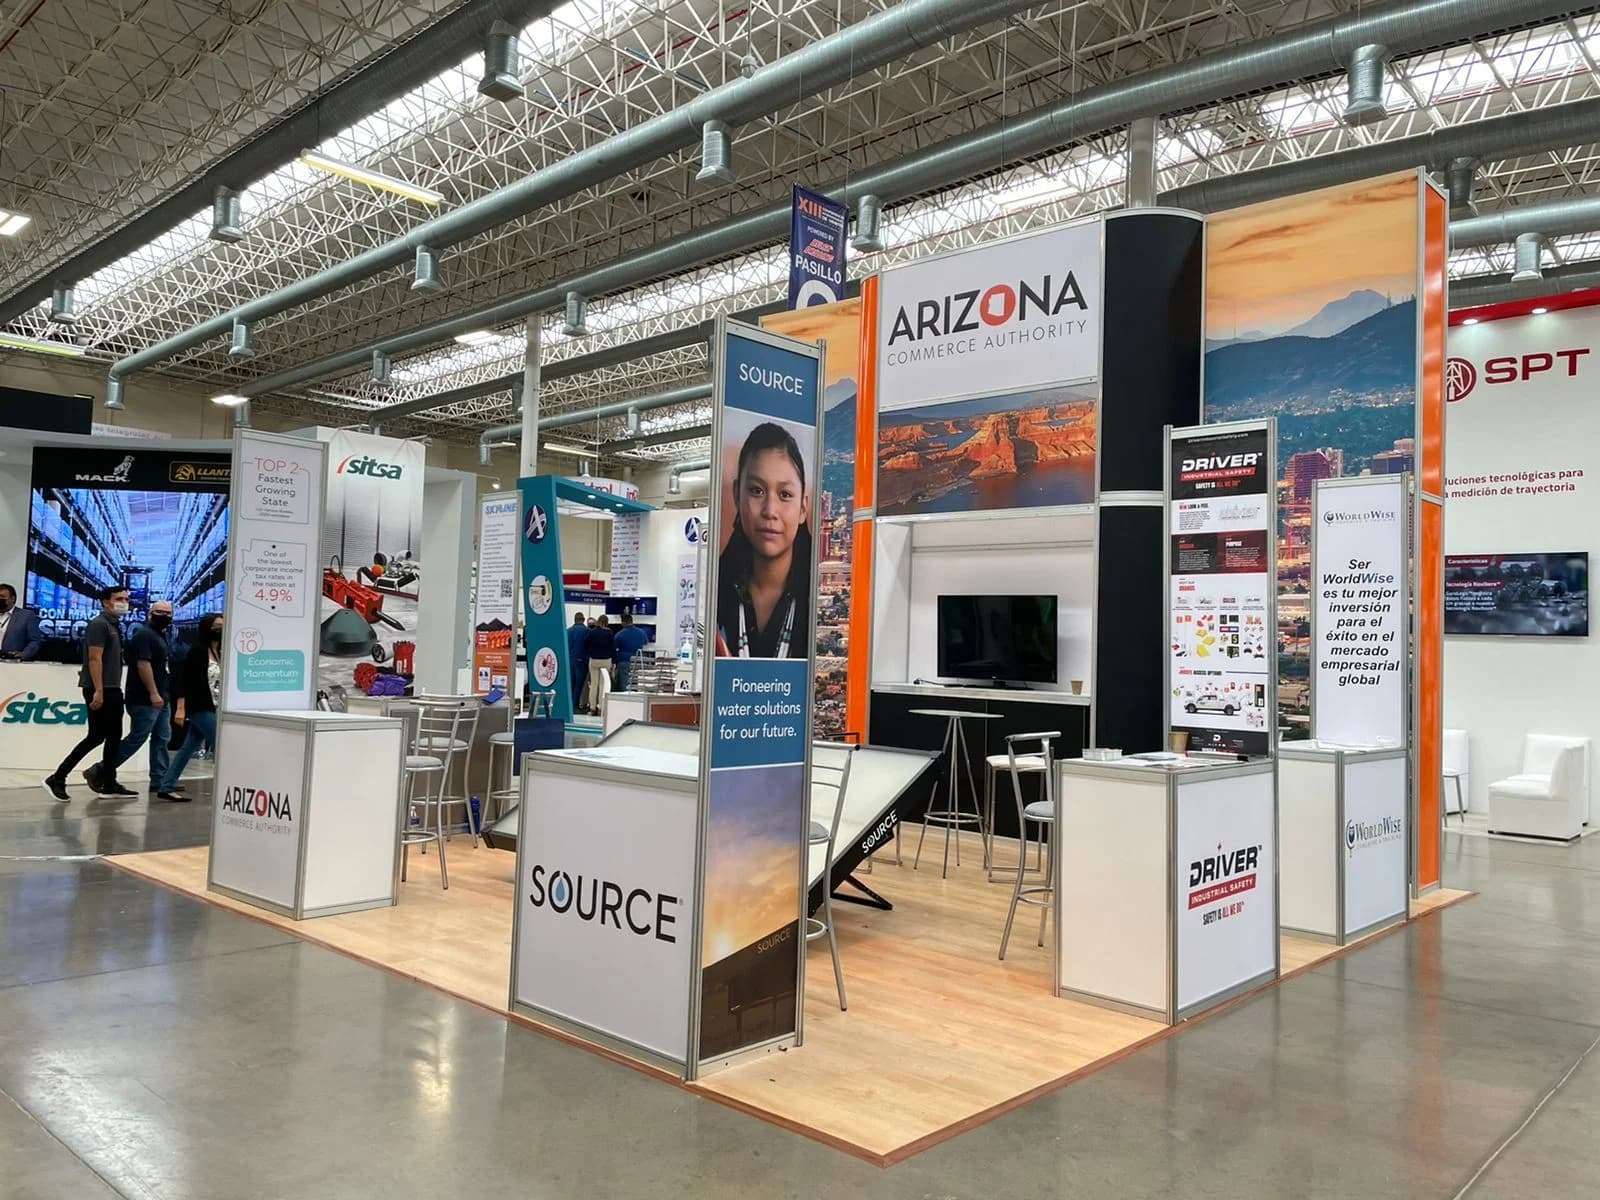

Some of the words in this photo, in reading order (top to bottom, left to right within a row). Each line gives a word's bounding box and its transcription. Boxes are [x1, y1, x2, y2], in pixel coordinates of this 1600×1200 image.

[798, 196, 822, 219] XIII
[795, 255, 842, 284] PASILLO
[888, 270, 1089, 346] ARIZONA
[887, 339, 977, 367] COMMERCE
[984, 318, 1088, 350] AUTHORITY
[1485, 348, 1590, 384] SPT
[738, 362, 804, 396] SOURCE
[254, 457, 288, 472] TOP
[289, 461, 299, 475] 2
[347, 456, 402, 480] sitsa
[1181, 451, 1258, 472] DRIVER
[75, 474, 127, 482] MACK
[197, 468, 231, 477] LLANT
[258, 473, 294, 485] Fastest
[1183, 471, 1222, 480] INDUSTRIAL
[1224, 468, 1255, 477] SAFETY
[1445, 476, 1487, 487] luciones
[1490, 469, 1556, 484] tecnológicas
[1558, 469, 1584, 482] para
[255, 485, 296, 498] Growing
[1451, 486, 1498, 499] medición
[1500, 486, 1514, 495] de
[1516, 482, 1576, 497] trayectoria
[262, 496, 289, 507] State
[264, 550, 278, 558] One
[1348, 559, 1372, 569] Ser
[1323, 573, 1394, 585] WorldWise
[255, 588, 292, 602] 4.9%
[1323, 590, 1339, 599] es
[1342, 589, 1355, 599] tu
[1358, 587, 1399, 602] mejor
[39, 608, 65, 620] CON
[70, 609, 100, 621] MAC
[1329, 602, 1391, 613] inversión
[1336, 618, 1367, 629] para
[1370, 616, 1383, 627] el
[241, 631, 258, 639] TOP
[1326, 630, 1358, 642] éxito
[1361, 633, 1378, 641] en
[1382, 631, 1395, 642] el
[240, 639, 258, 652] 10
[1330, 645, 1389, 657] mercado
[247, 656, 295, 667] Economic
[1321, 660, 1400, 672] empresarial
[243, 669, 299, 679] Momentum
[1338, 674, 1381, 687] global
[732, 678, 791, 696] Pioneering
[2, 692, 87, 725] sitsa
[717, 704, 751, 716] water
[753, 700, 801, 716] solutions
[720, 724, 738, 740] for
[740, 728, 760, 739] our
[762, 722, 797, 738] future.
[222, 785, 292, 821] ARIZONA
[862, 808, 898, 854] SOURCE
[1189, 845, 1259, 888] DRIVER
[1191, 885, 1229, 905] INDUSTRIAL
[1230, 877, 1254, 892] SAFETY
[530, 864, 679, 945] SOURCE
[757, 927, 792, 954] SOURCE
